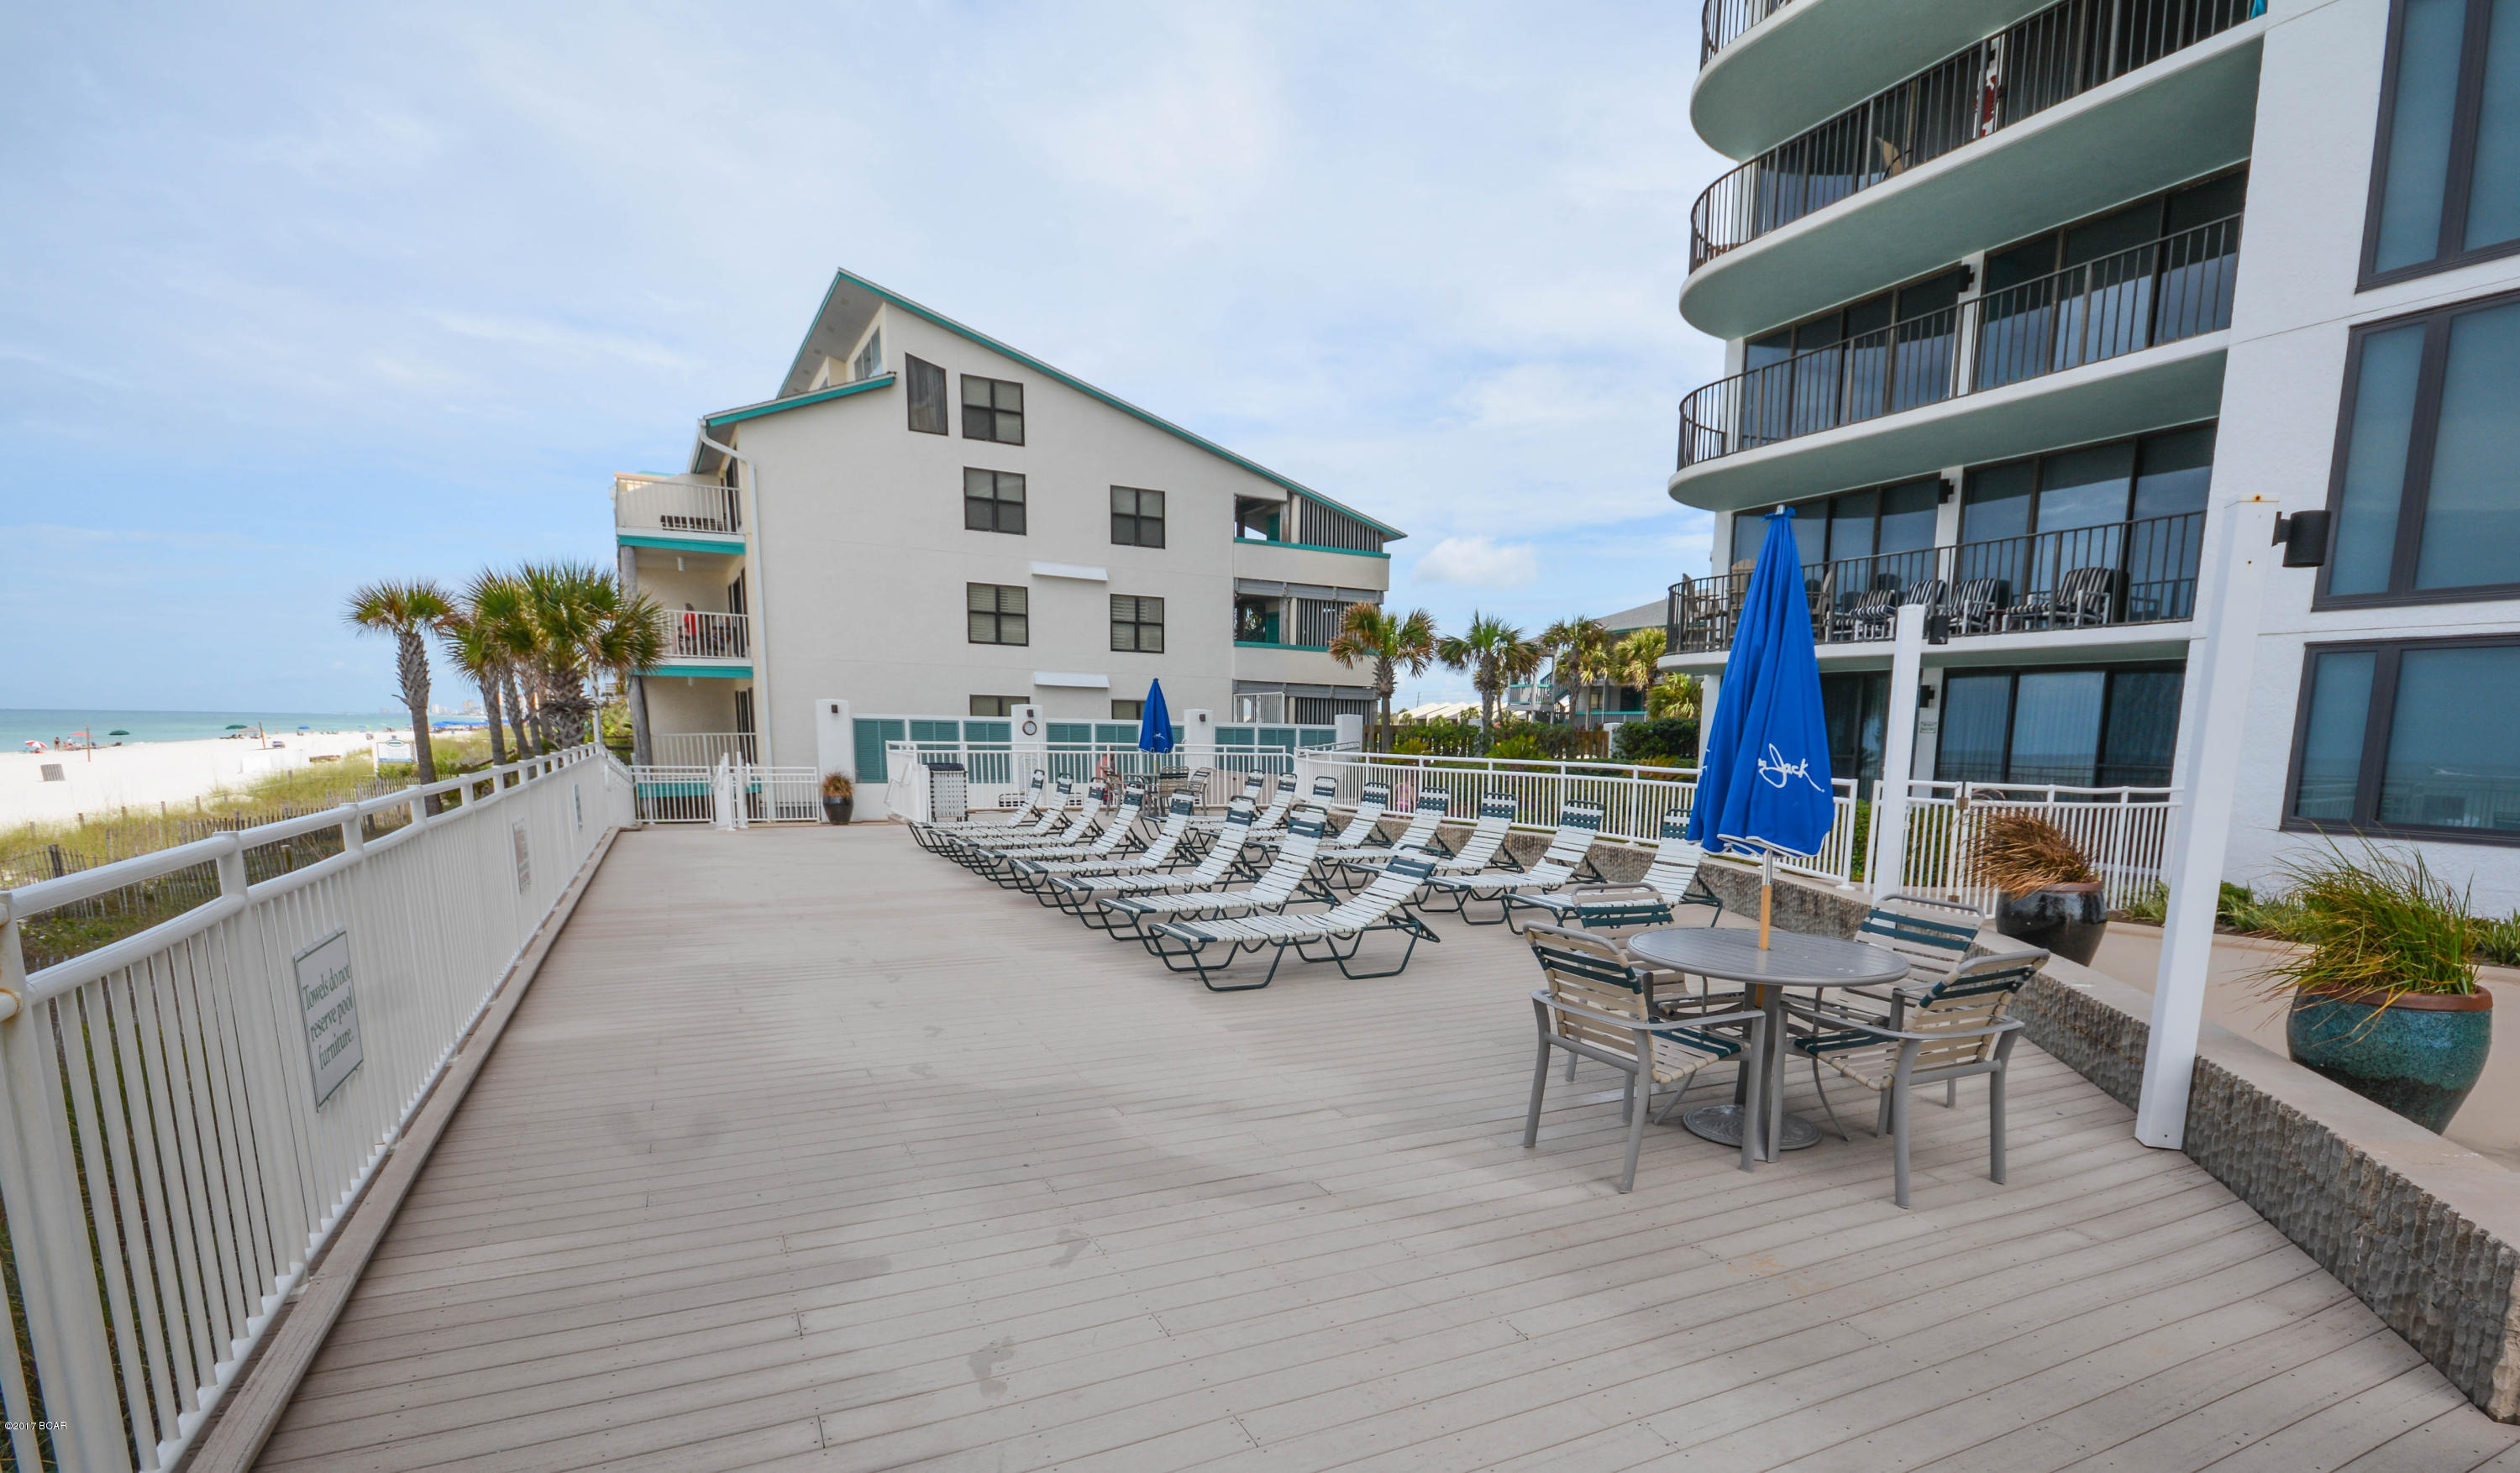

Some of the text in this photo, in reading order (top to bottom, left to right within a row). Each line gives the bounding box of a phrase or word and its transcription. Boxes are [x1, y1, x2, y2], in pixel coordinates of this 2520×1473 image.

[302, 964, 350, 1011] Towels do not
[310, 986, 353, 1042] reserve pool
